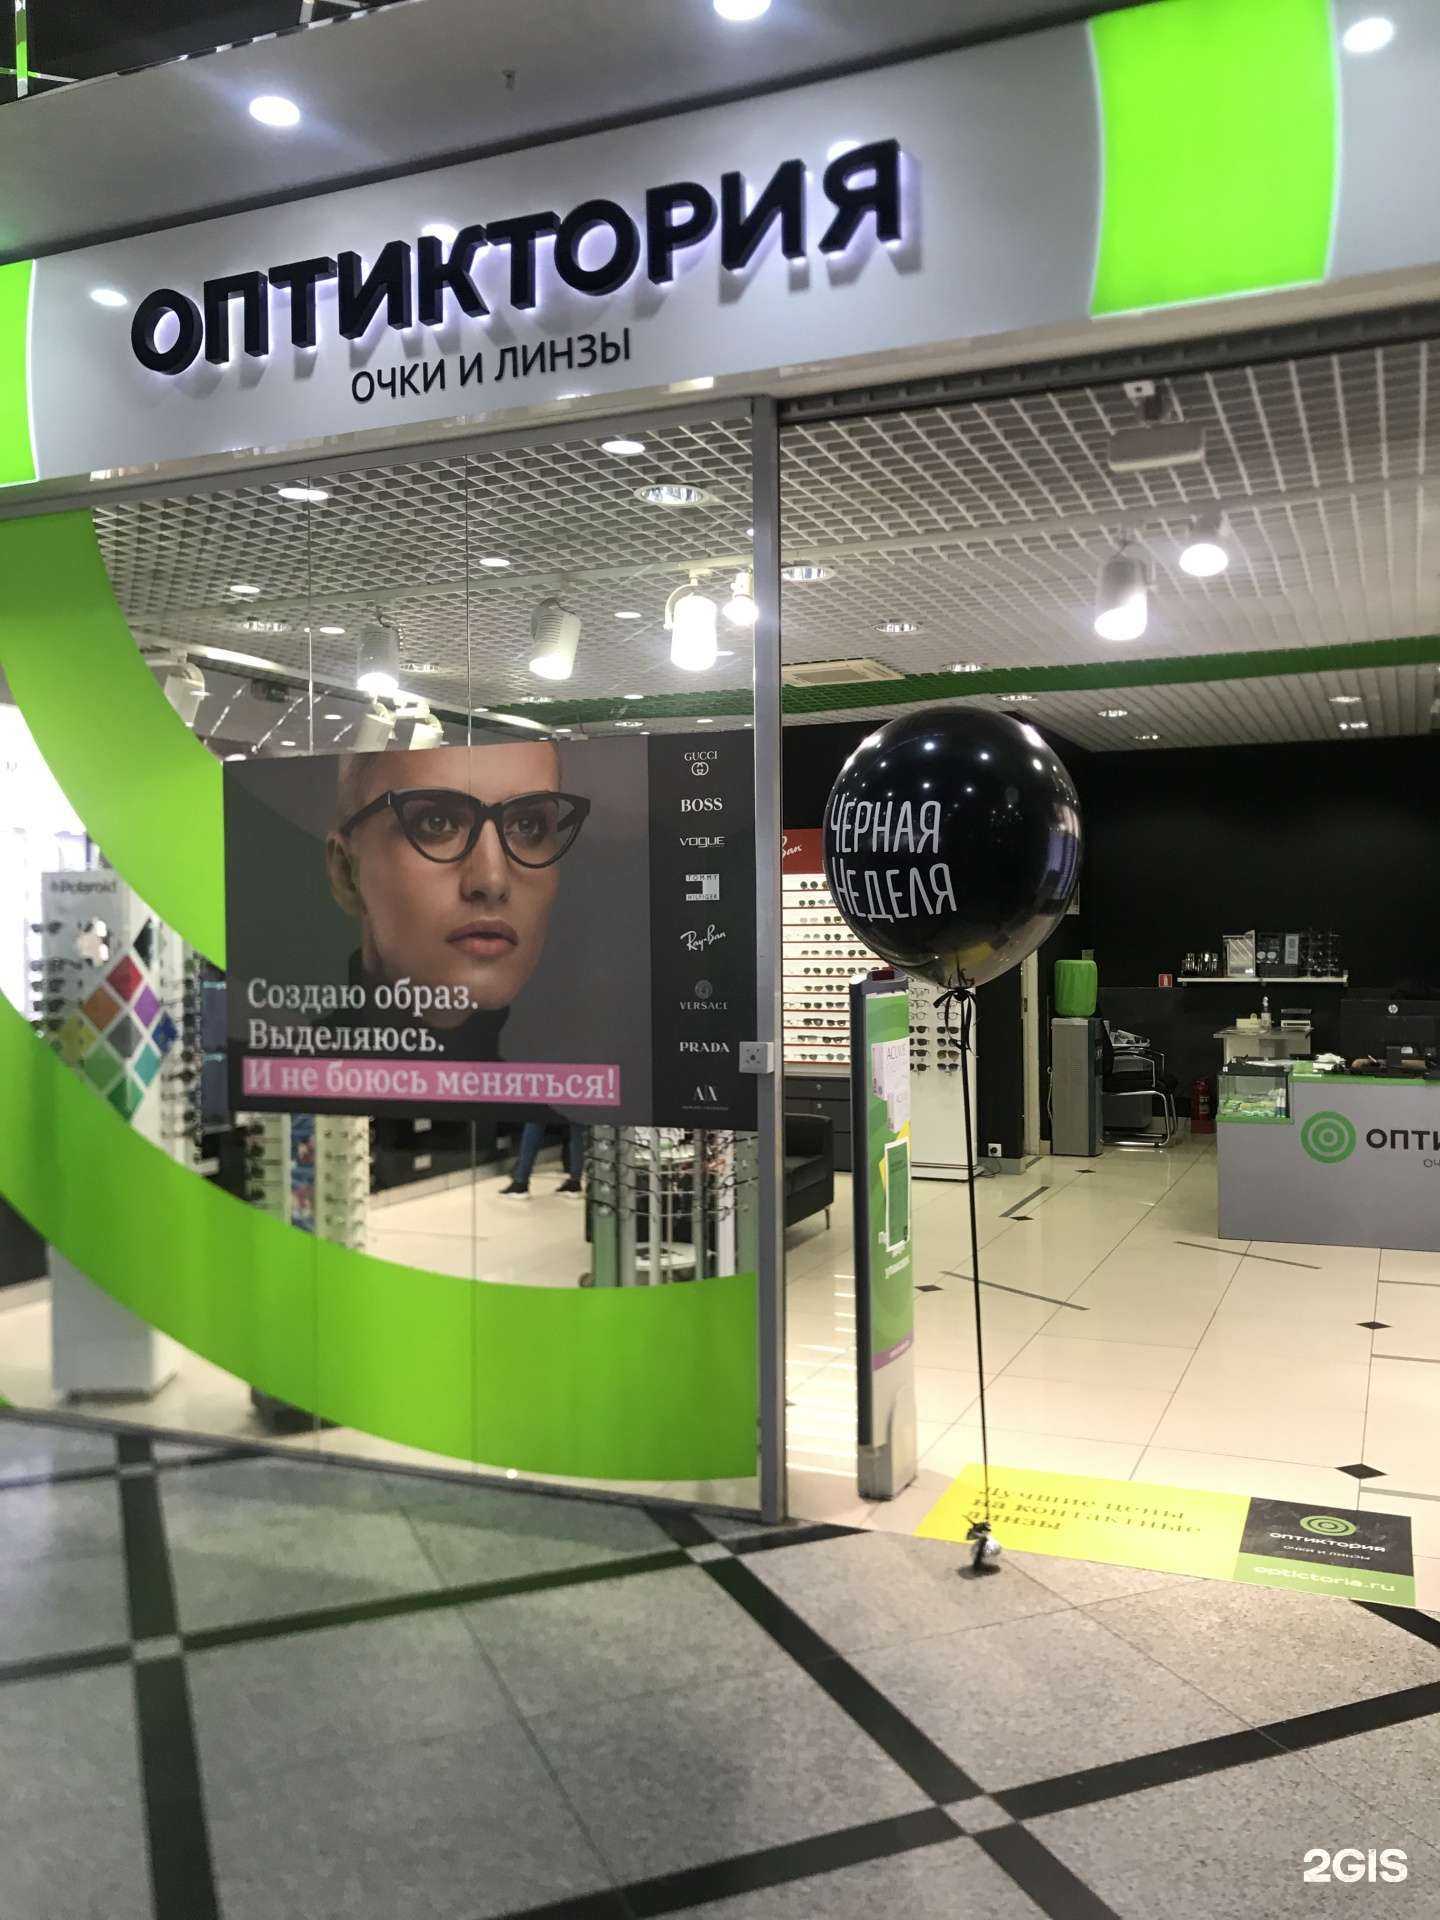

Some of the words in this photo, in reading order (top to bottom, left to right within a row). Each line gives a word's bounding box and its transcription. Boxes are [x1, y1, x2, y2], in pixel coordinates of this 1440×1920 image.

[131, 138, 902, 376] ОПТИКТОРИЯ
[350, 359, 446, 402] ОЧКИ
[460, 353, 484, 386] И
[494, 328, 631, 383] ЛИНЗЫ
[684, 751, 718, 761] GUCCI
[681, 798, 723, 812] BOSS
[830, 794, 941, 854] ЧЕРНАЯ
[832, 857, 957, 923] НЕДЕЛЯ
[248, 977, 365, 1013] Создаю
[375, 978, 479, 1017] образ.
[680, 1002, 728, 1010] VERSACE
[249, 1019, 445, 1055] Выделяюсь.
[680, 1042, 730, 1053] PRADA
[249, 1060, 272, 1090] И
[281, 1066, 318, 1091] не
[325, 1060, 428, 1095] боюсь
[437, 1068, 616, 1099] меняться!
[1253, 1566, 1396, 1592] optictoria.ru
